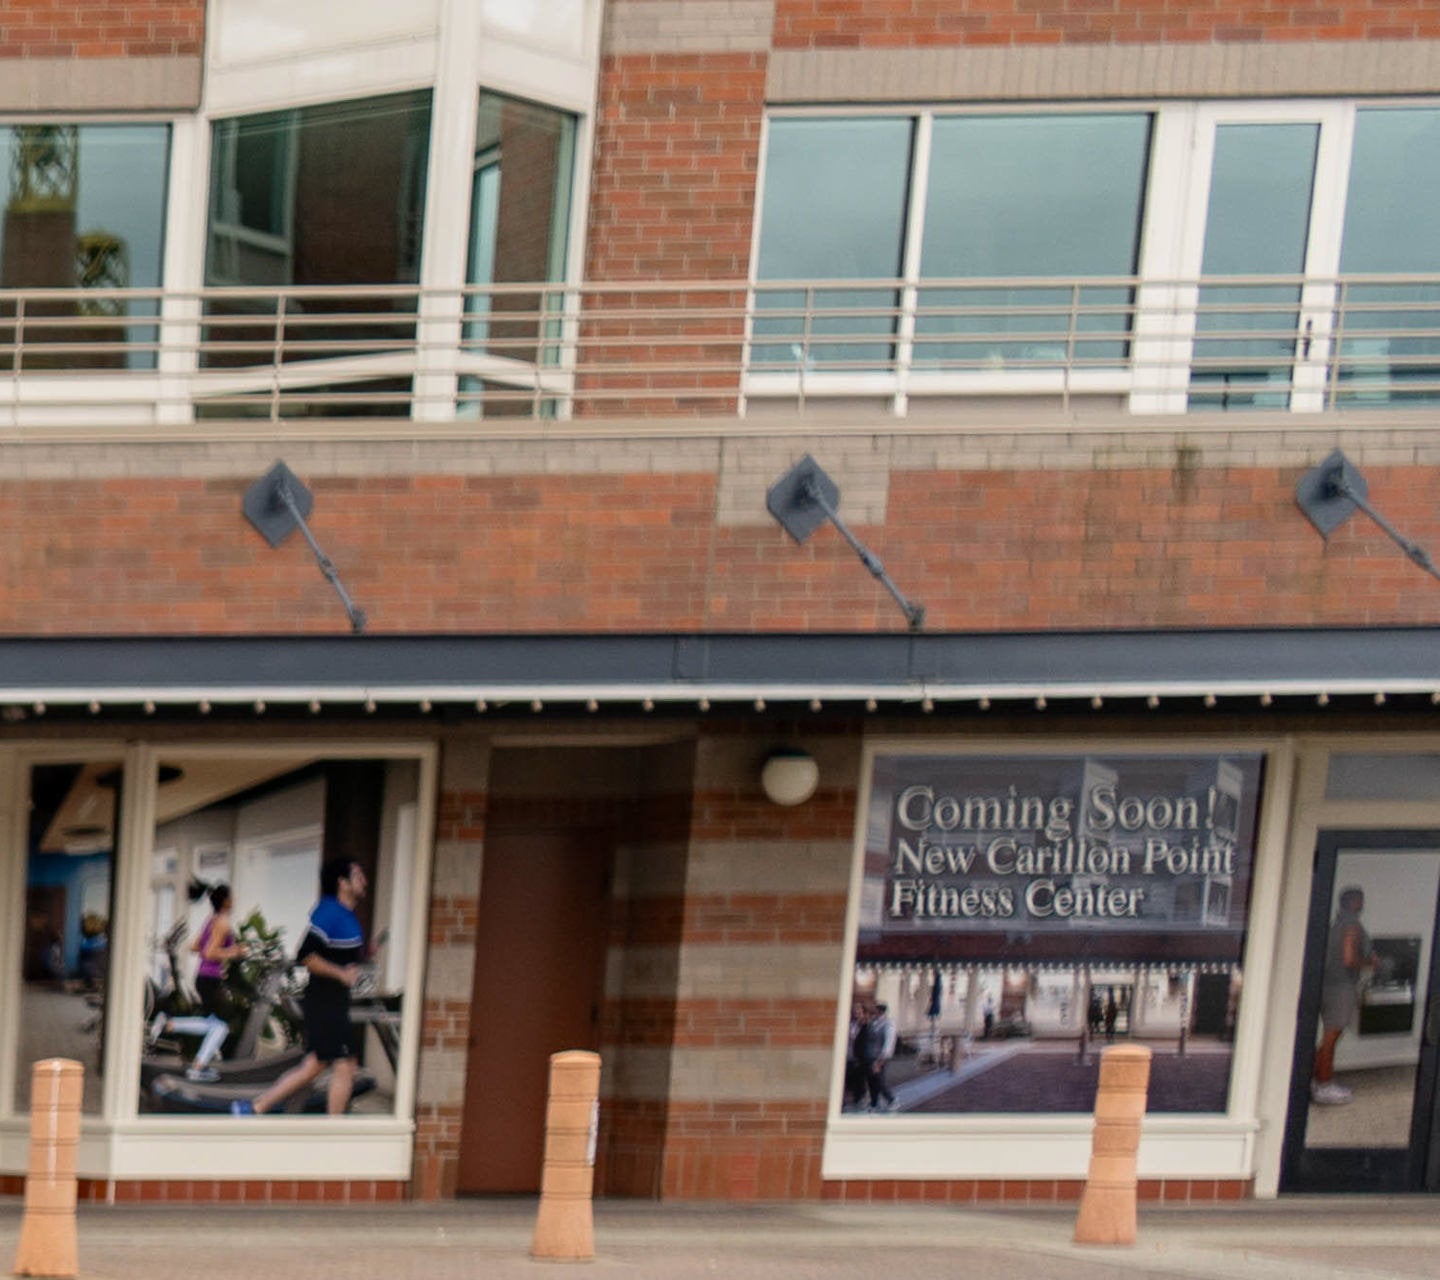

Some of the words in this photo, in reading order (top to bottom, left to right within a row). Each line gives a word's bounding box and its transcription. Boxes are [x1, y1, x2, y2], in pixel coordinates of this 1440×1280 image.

[897, 784, 1074, 842] Coming
[1088, 785, 1217, 830] Soon!
[894, 837, 976, 875] New
[986, 836, 1130, 875] Carillon
[1143, 837, 1236, 875] Point
[891, 878, 1014, 918] Fitness
[1026, 878, 1144, 917] Center
